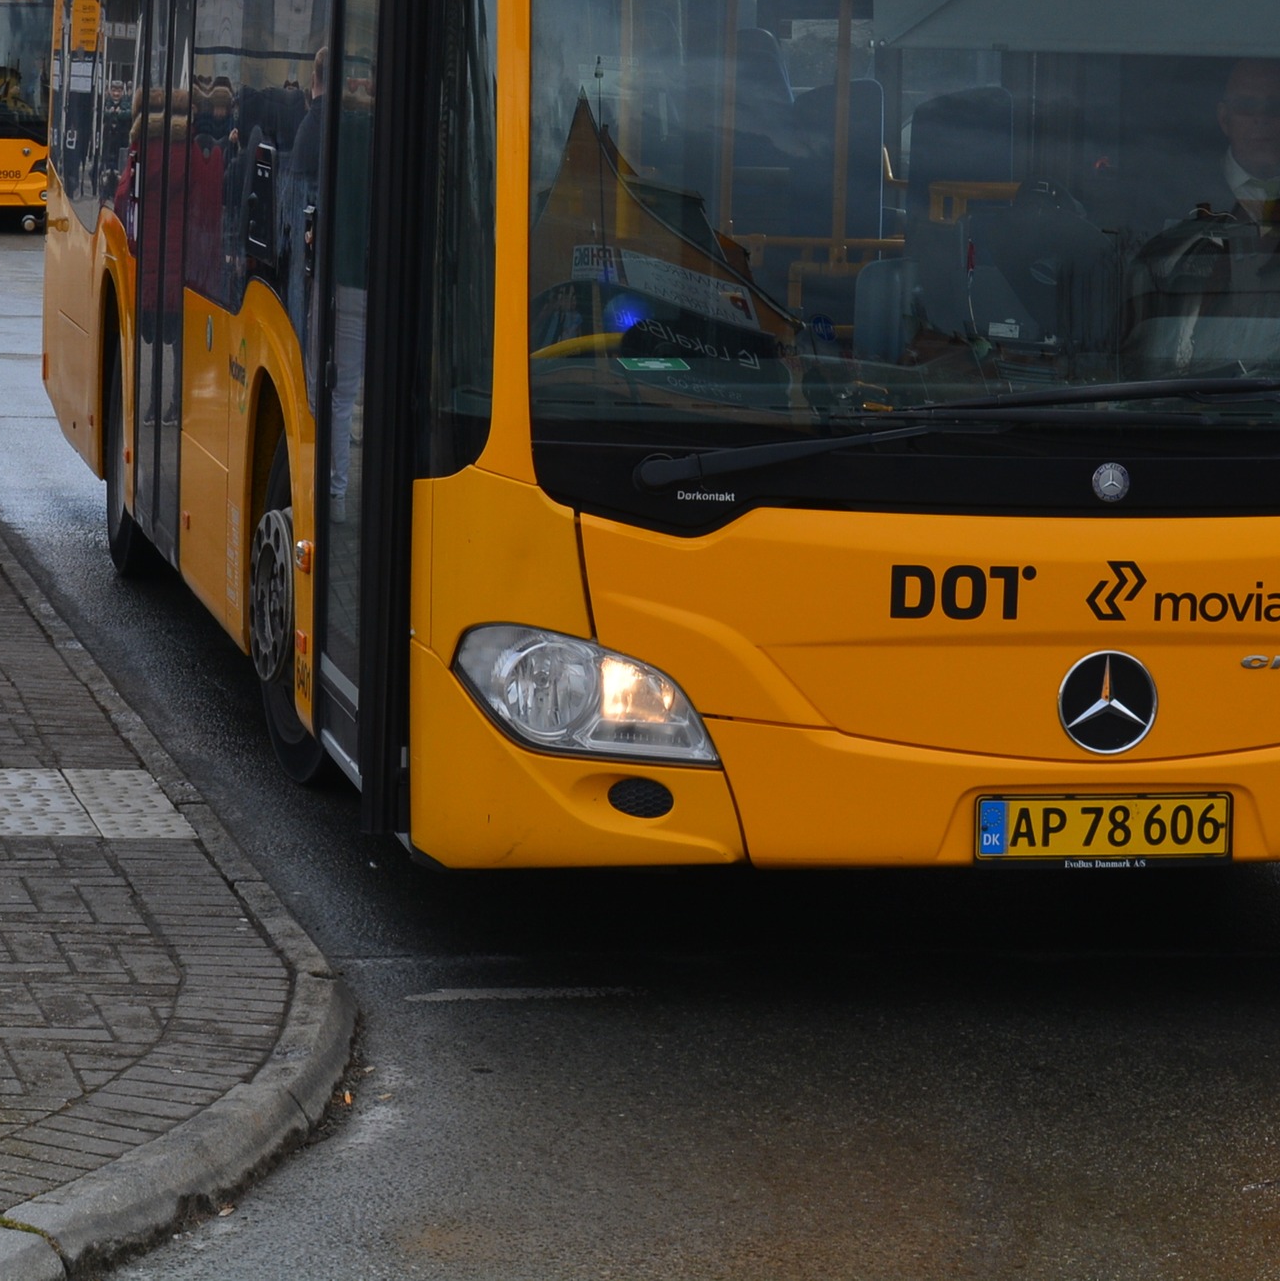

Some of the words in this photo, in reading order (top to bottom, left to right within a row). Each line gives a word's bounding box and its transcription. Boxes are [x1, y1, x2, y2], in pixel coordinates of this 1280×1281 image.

[677, 490, 735, 502] Dørkontakt
[890, 564, 1037, 620] DOT
[1010, 807, 1067, 847] AP
[1081, 805, 1132, 847] 78
[1143, 803, 1220, 846] 606
[983, 833, 1000, 846] DK
[1064, 860, 1093, 869] EvoBus
[1095, 860, 1130, 869] Danmark
[1133, 859, 1146, 868] A/S
